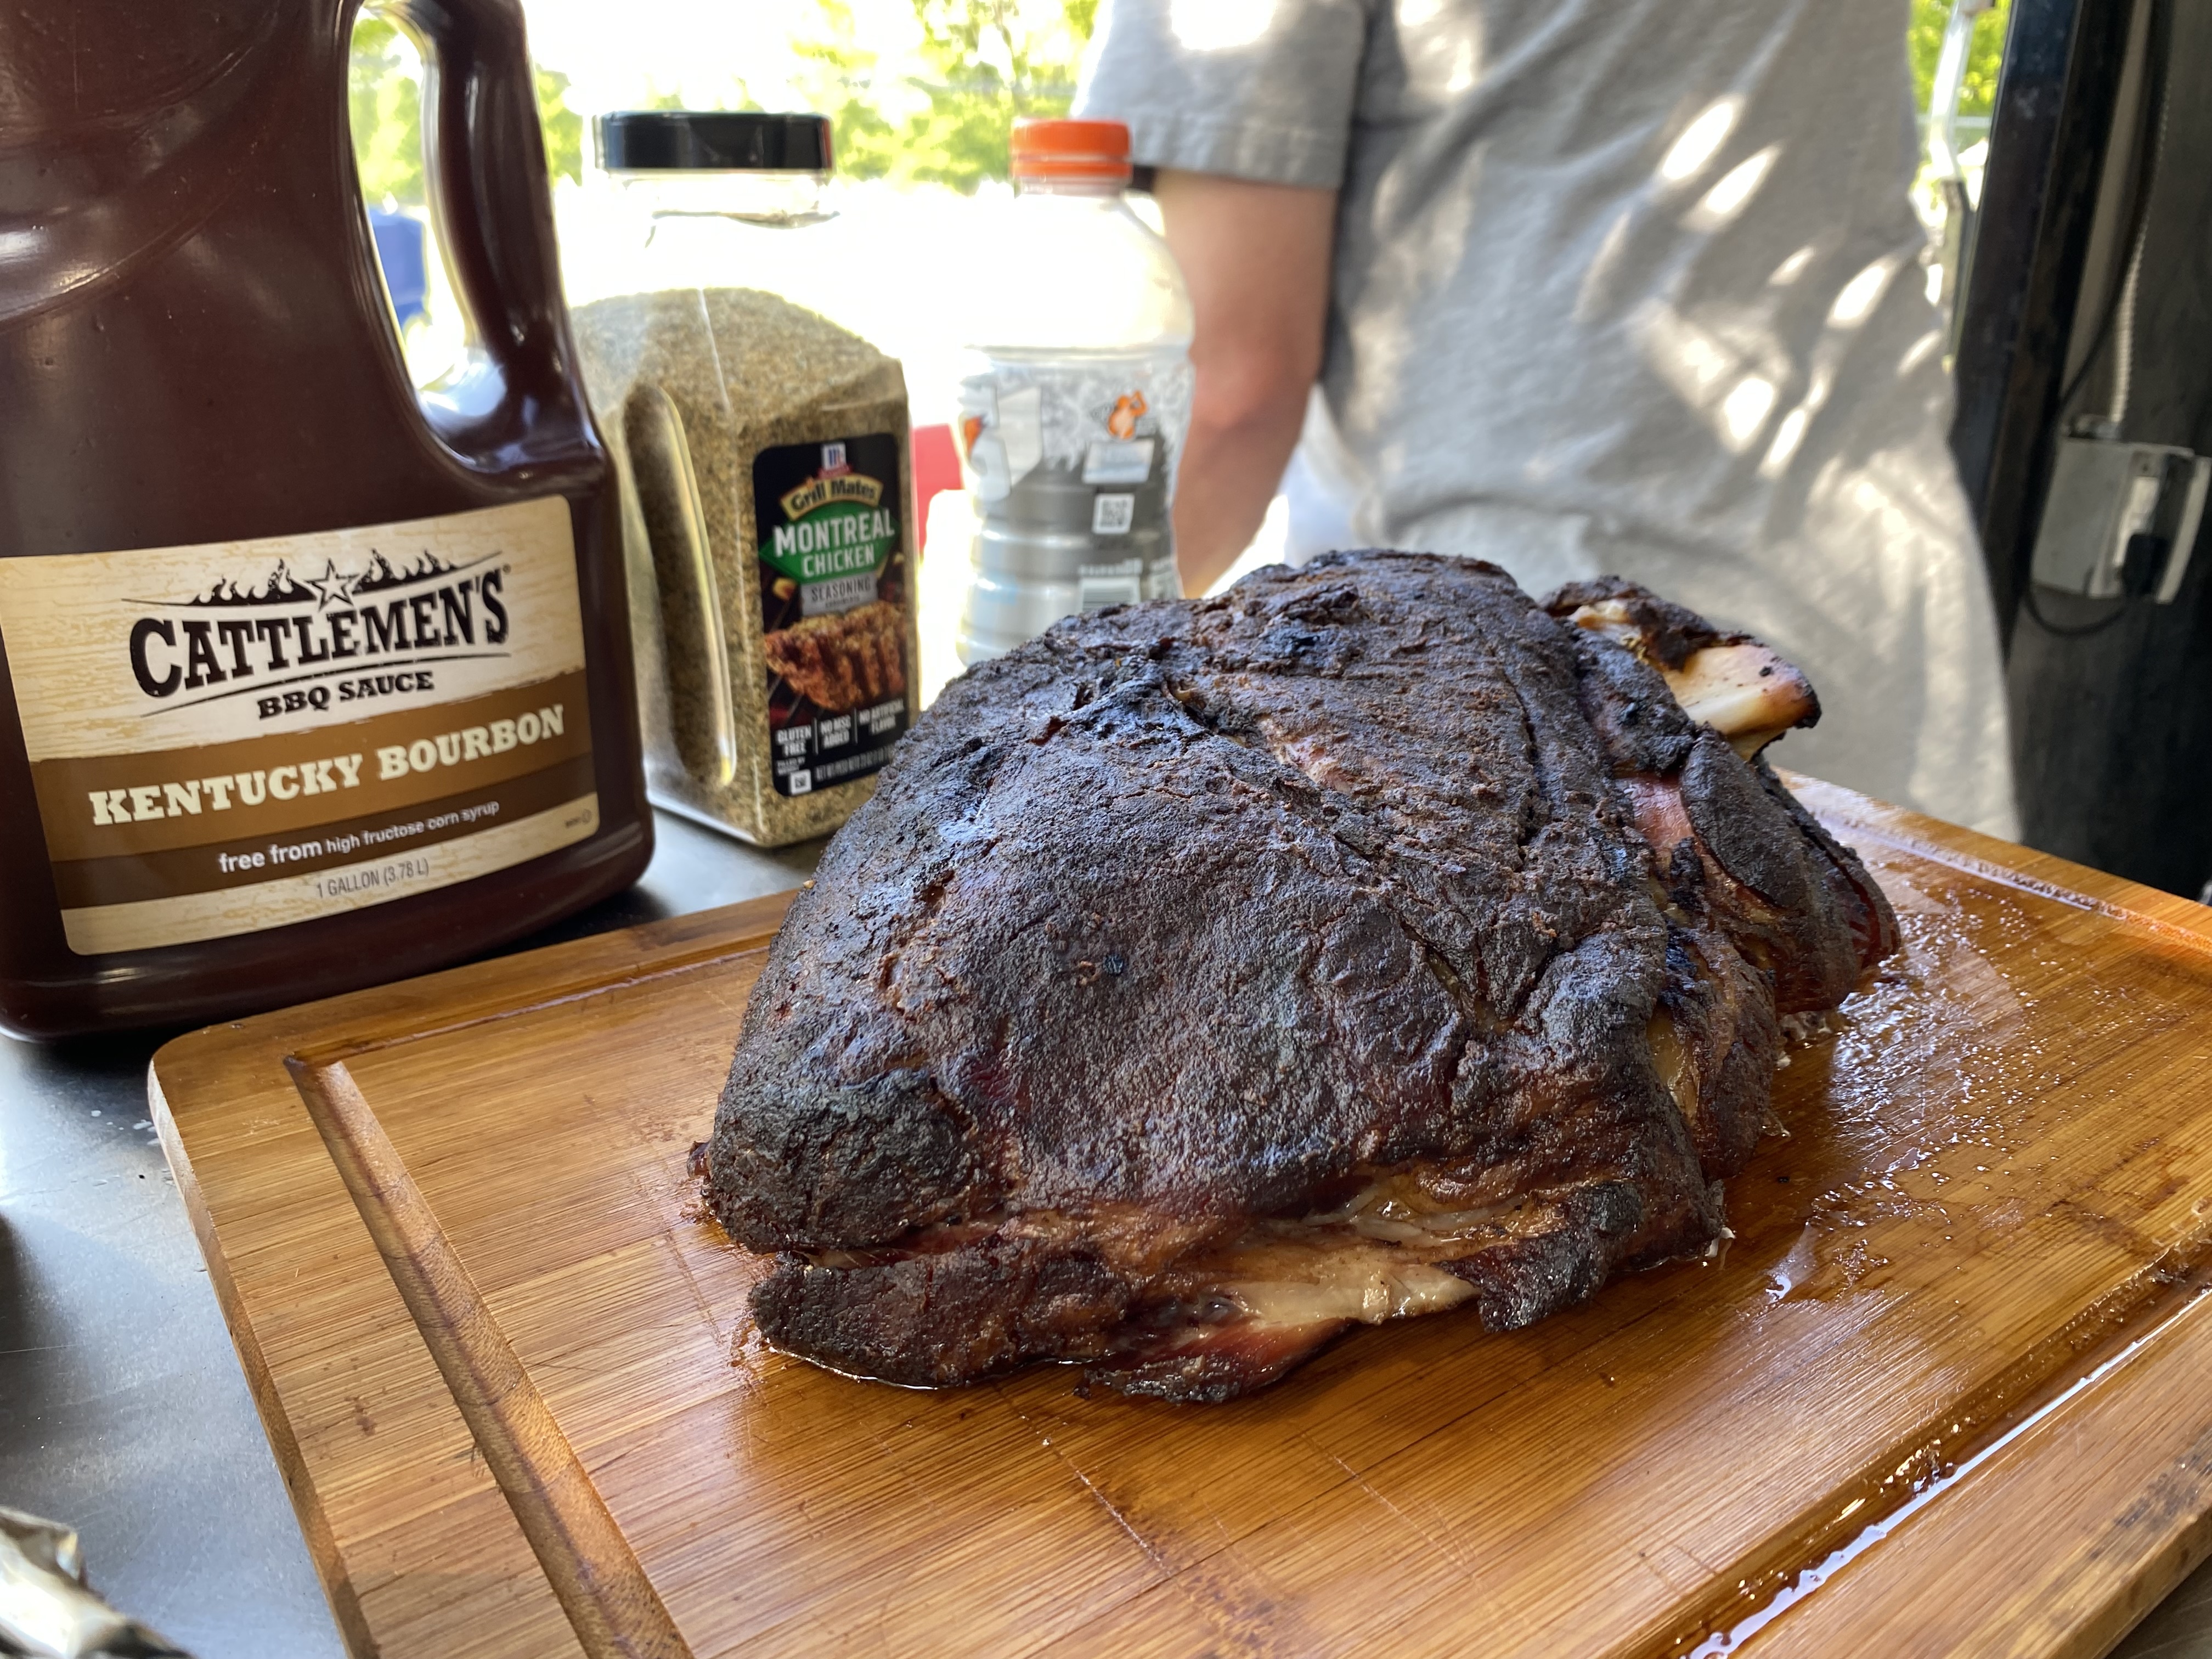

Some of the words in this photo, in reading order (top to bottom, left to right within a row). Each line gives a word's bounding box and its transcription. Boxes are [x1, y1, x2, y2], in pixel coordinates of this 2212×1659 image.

[792, 482, 825, 510] Grill
[831, 480, 874, 498] Mates
[773, 508, 895, 557] MONTREAL
[803, 543, 874, 578] CHICKEN
[811, 577, 871, 602] SEASONING
[257, 685, 330, 720] BBQ
[339, 670, 435, 703] SAUCE
[777, 726, 811, 744] GLUTEN
[88, 754, 363, 826] KENTUCKY
[375, 704, 566, 781] BOURBON
[218, 853, 266, 873] free
[270, 841, 322, 864] from
[326, 835, 360, 854] high
[362, 821, 424, 846] fructose
[428, 812, 459, 830] corn
[461, 800, 500, 823] syrup
[317, 884, 323, 899] 1
[328, 870, 380, 896] GALLON
[382, 861, 414, 888] (3.78
[417, 857, 430, 877] L)
